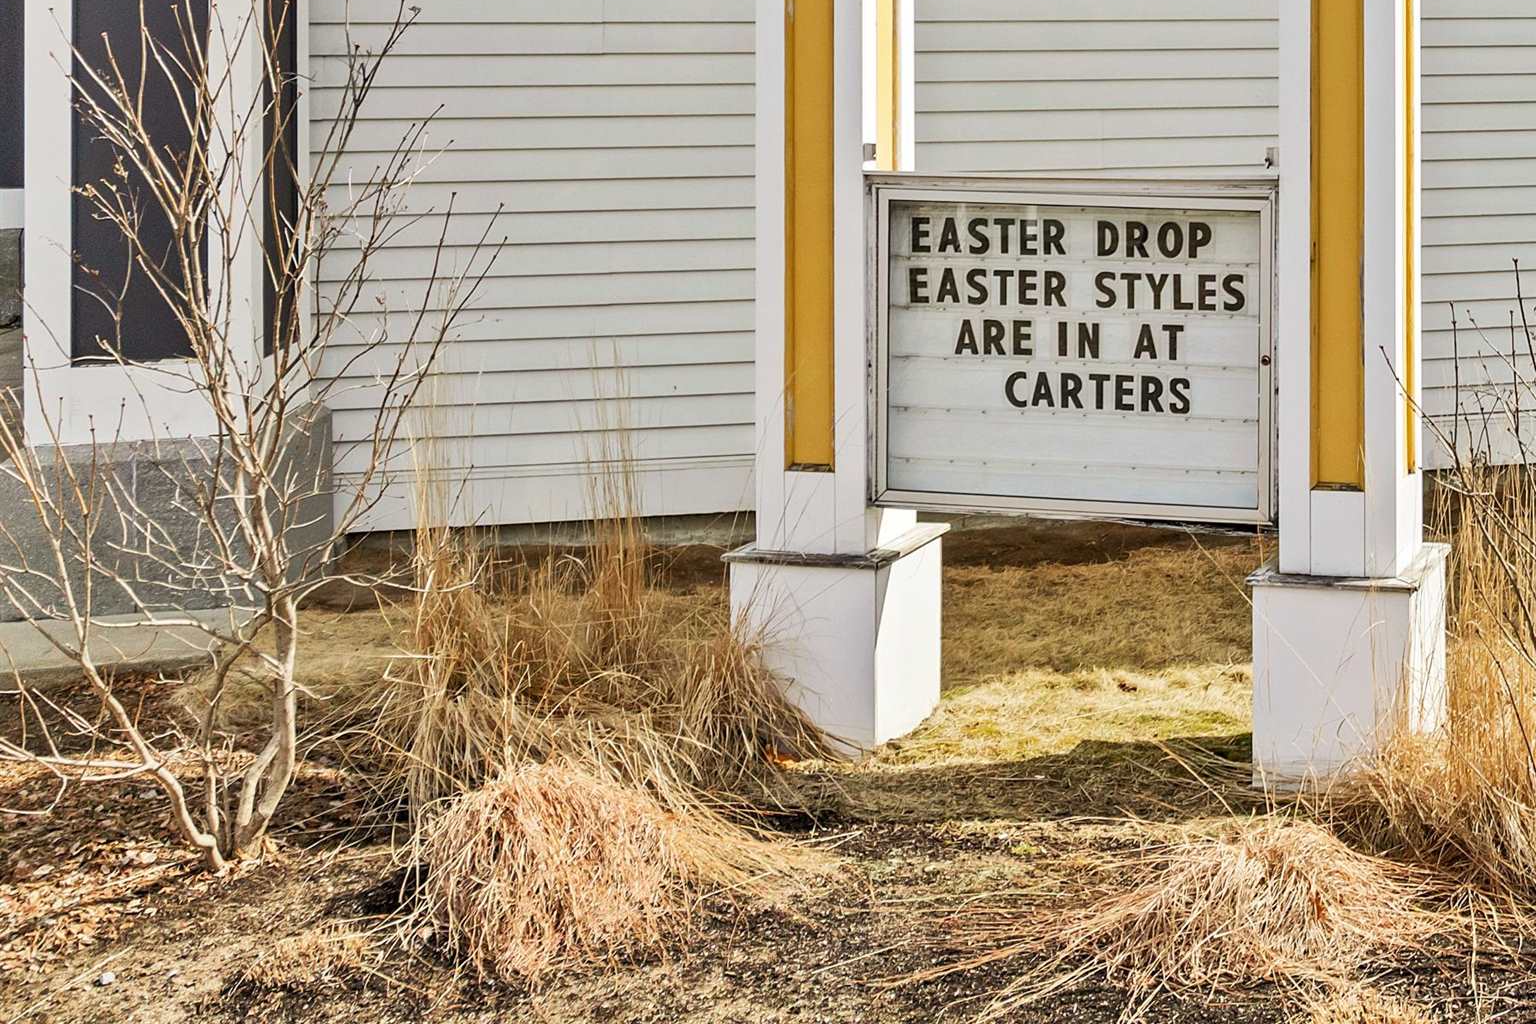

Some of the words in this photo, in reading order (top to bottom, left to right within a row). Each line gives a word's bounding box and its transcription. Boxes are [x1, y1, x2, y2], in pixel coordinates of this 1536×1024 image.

[911, 216, 1066, 256] EASTER
[1097, 220, 1212, 259] DROP
[908, 267, 1067, 307] EASTER
[1094, 271, 1246, 312] STYLES
[954, 319, 1034, 356] ARE
[1057, 321, 1100, 359] IN
[1133, 323, 1185, 361] AT
[1005, 371, 1191, 415] CARTERS
